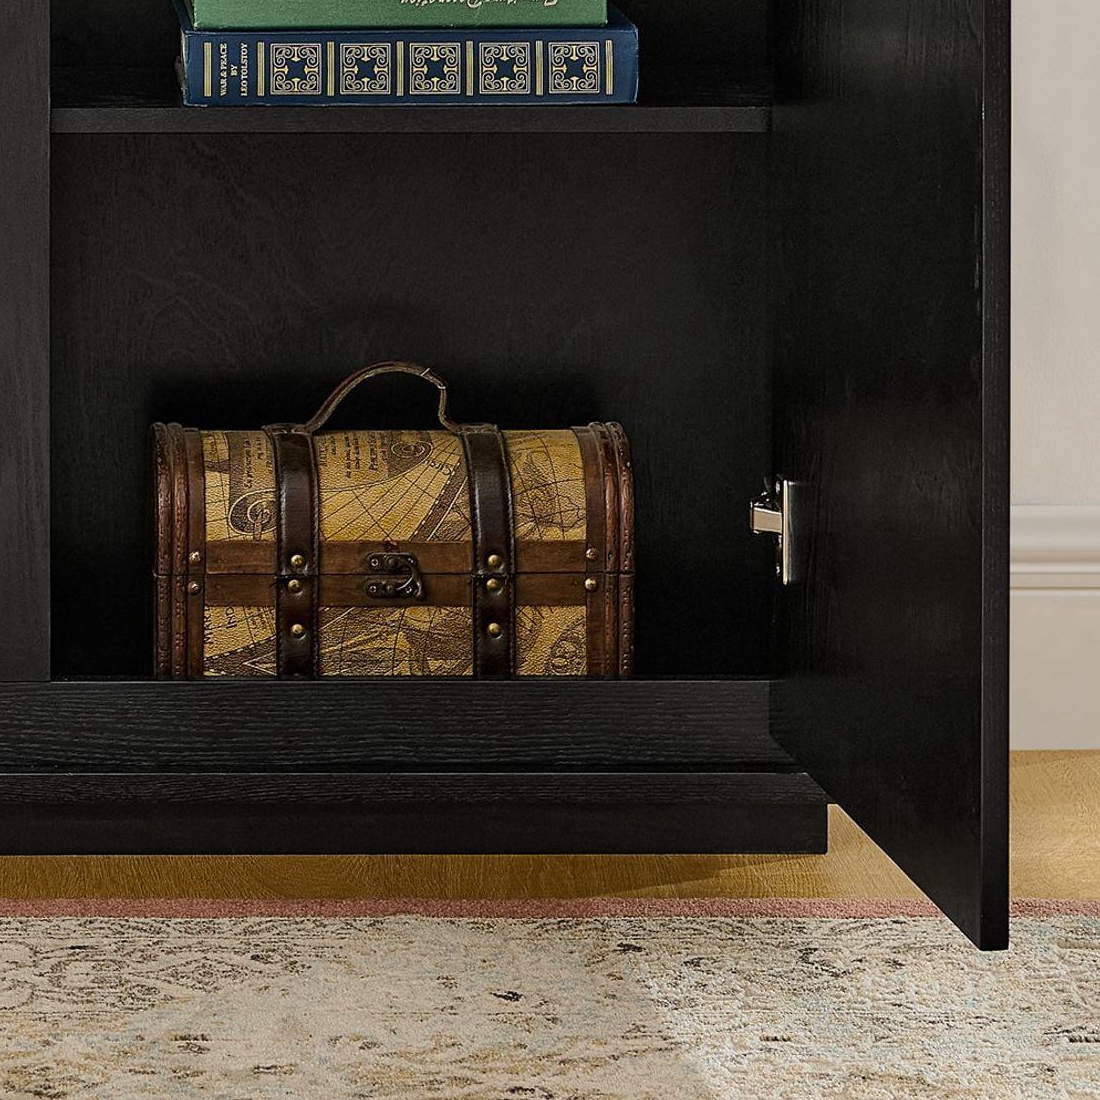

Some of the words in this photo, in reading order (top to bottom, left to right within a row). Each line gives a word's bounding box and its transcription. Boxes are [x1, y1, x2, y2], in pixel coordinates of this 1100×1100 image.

[240, 42, 248, 80] TOLSTOY
[230, 64, 238, 77] BY
[240, 80, 248, 96] LEO
